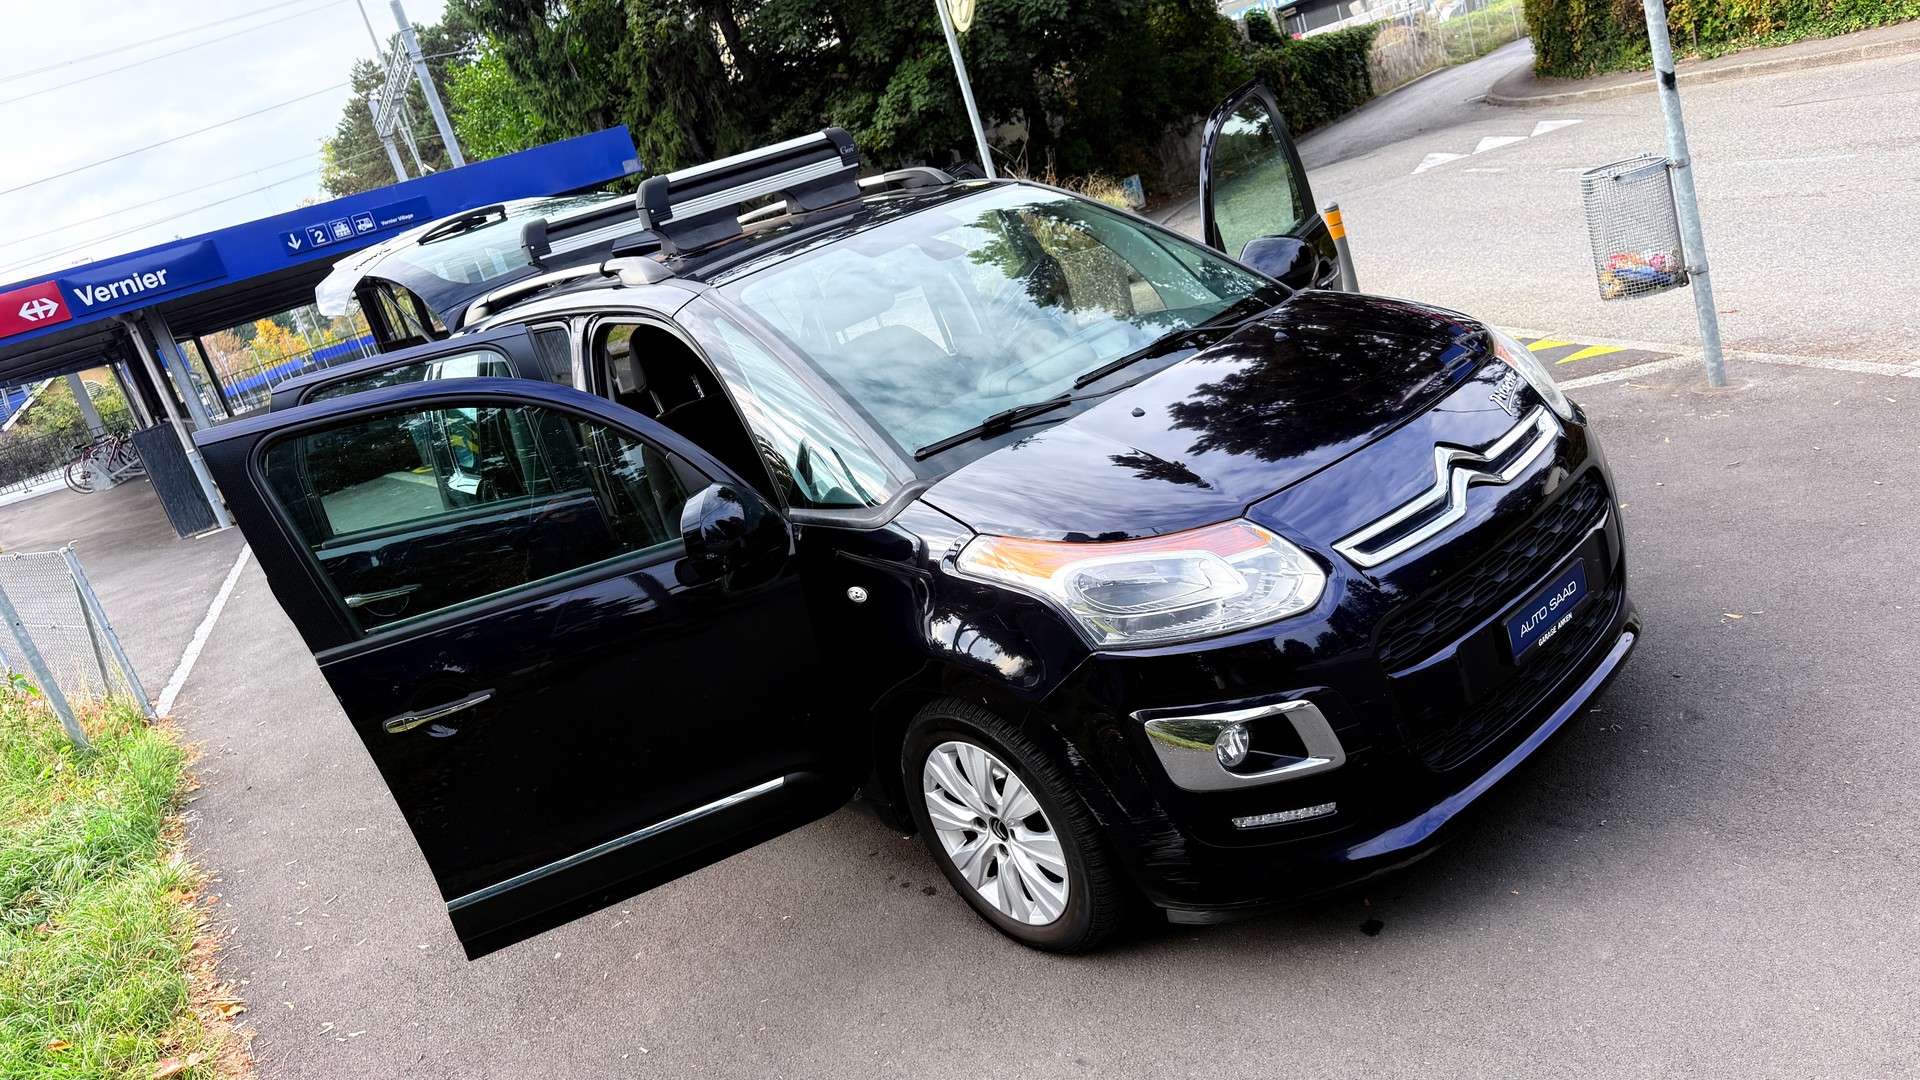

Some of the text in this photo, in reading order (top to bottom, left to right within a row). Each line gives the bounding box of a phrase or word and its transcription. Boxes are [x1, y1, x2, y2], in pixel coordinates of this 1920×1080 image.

[380, 213, 414, 226] Vernier Village
[314, 230, 326, 243] 2
[73, 268, 167, 306] Vernier
[1520, 580, 1577, 638] AUTO SAAD
[1538, 625, 1557, 647] GARAGE
